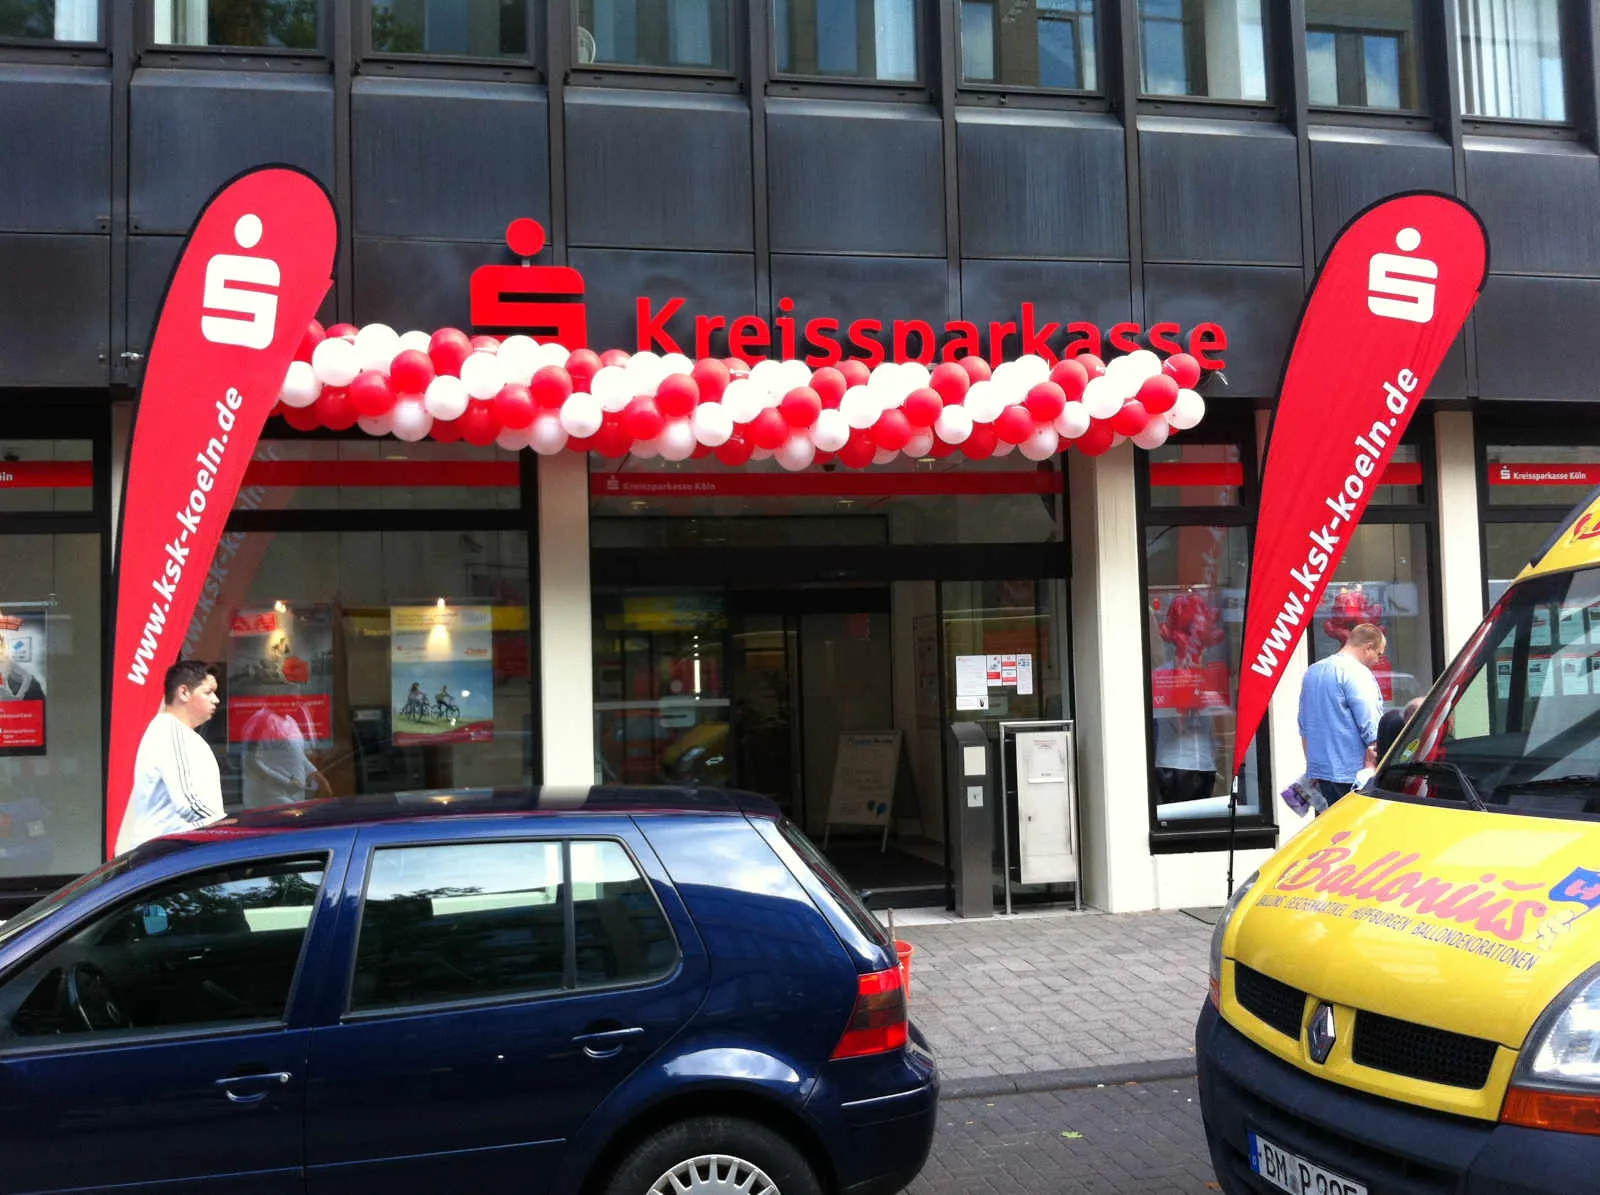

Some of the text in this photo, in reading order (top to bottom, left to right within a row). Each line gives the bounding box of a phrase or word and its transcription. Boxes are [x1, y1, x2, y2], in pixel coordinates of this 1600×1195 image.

[635, 296, 1228, 370] Kreissparkasse
[1513, 472, 1568, 481] Kreissparkasse
[1569, 471, 1587, 480] Köln
[127, 386, 243, 687] www.ksk-koeln.de
[1250, 367, 1419, 679] www.ksk-koeln.de
[1278, 842, 1547, 942] Ballonius
[1411, 920, 1538, 973] BALLONDEKORATIONEN
[1264, 1143, 1289, 1188] BM
[1298, 1162, 1311, 1195] P
